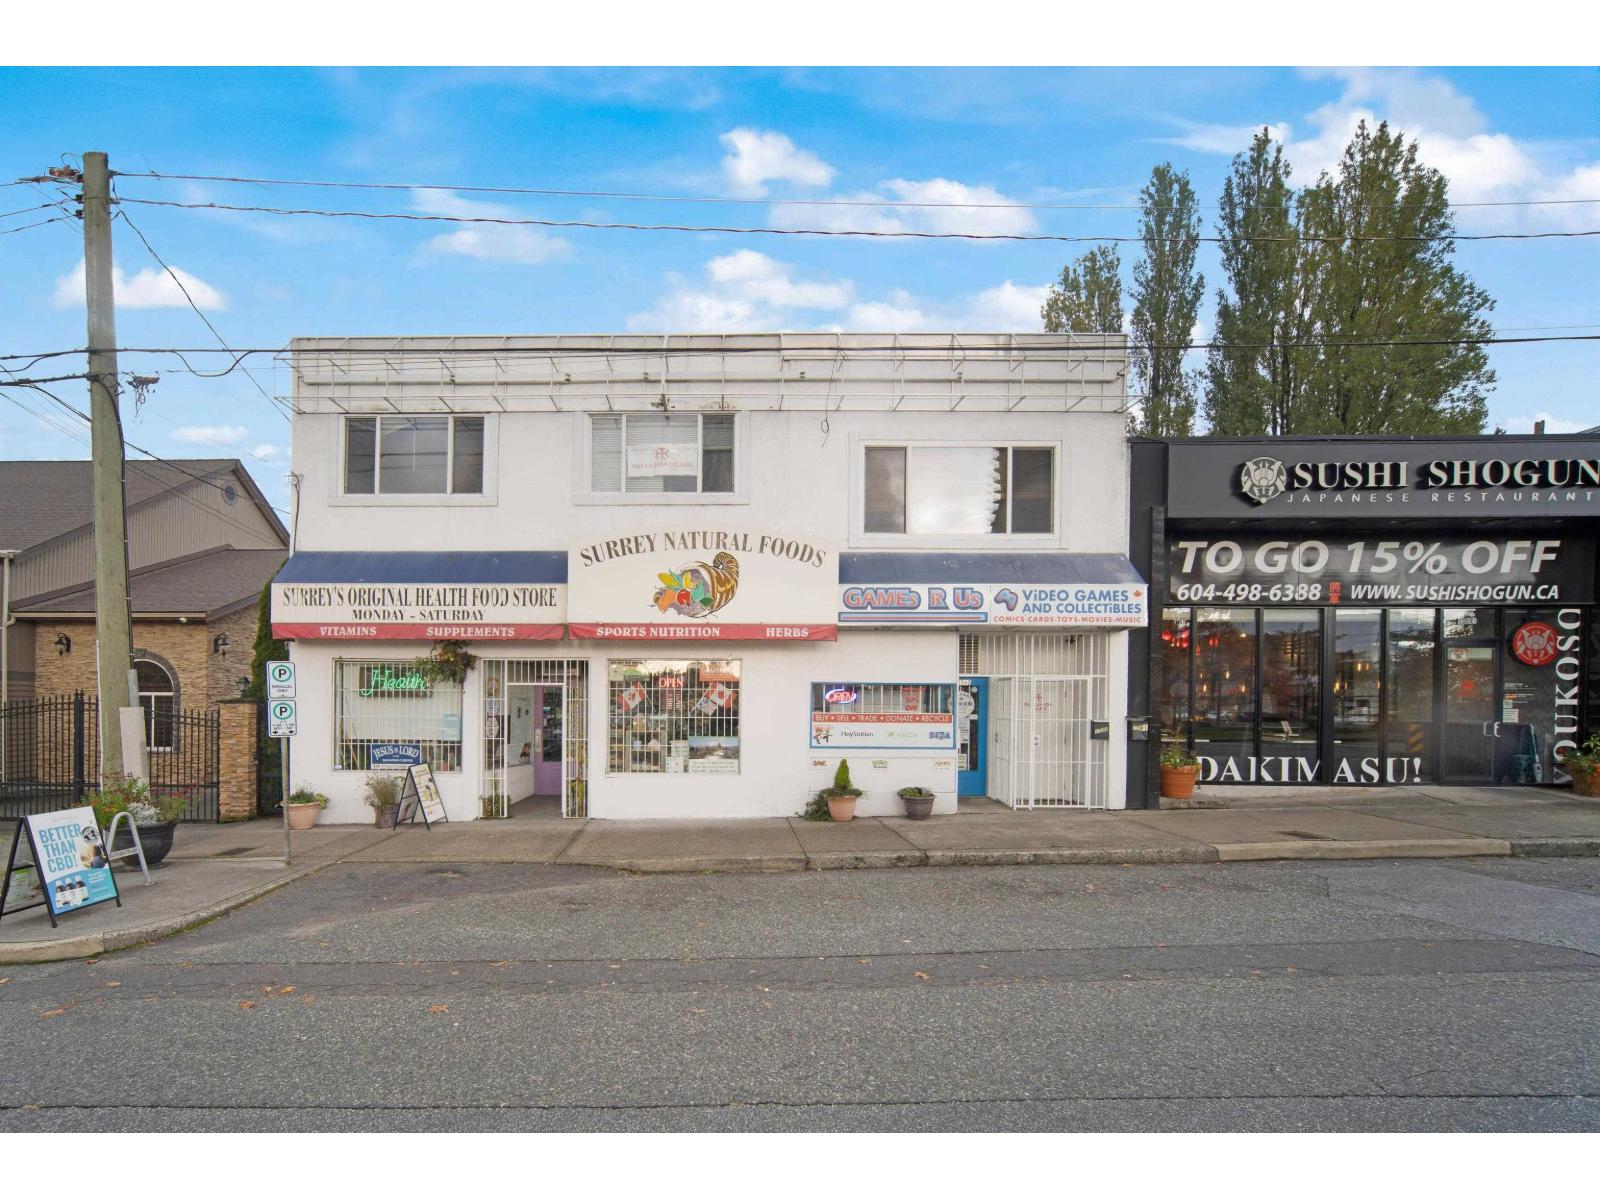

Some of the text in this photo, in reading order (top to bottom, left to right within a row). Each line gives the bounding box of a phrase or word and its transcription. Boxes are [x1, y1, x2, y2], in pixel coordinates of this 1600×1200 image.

[1294, 459, 1600, 488] SUSHI SHOGUN
[1287, 491, 1593, 503] JAPANESE RESTAURANT
[580, 530, 826, 568] SURREY NATURAL FOODS
[1178, 540, 1561, 574] TO GO 15% OFF
[283, 586, 557, 607] SURREY'S ORIGINAL HEALTH FOOD STORE
[927, 586, 949, 610] R
[1074, 590, 1129, 602] GAMES
[1176, 583, 1322, 602] 604-498-6388
[352, 609, 405, 621] MONDAY
[419, 609, 484, 621] SATURDAY
[1022, 603, 1051, 614] AND
[319, 626, 515, 638] VITAMINS SUPPLEMENTS
[596, 626, 809, 638] SPORTS NUTRITION HERBS
[278, 668, 287, 679] P
[659, 677, 684, 688] OPEN
[828, 690, 852, 704] OPEN
[279, 706, 288, 717] P
[837, 714, 850, 722] SELL
[929, 731, 951, 740] SEGA
[373, 745, 393, 760] JESUS
[399, 745, 419, 758] LORD
[39, 823, 81, 844] BETTER
[43, 839, 77, 858] THAN
[47, 854, 79, 873] CBD!
